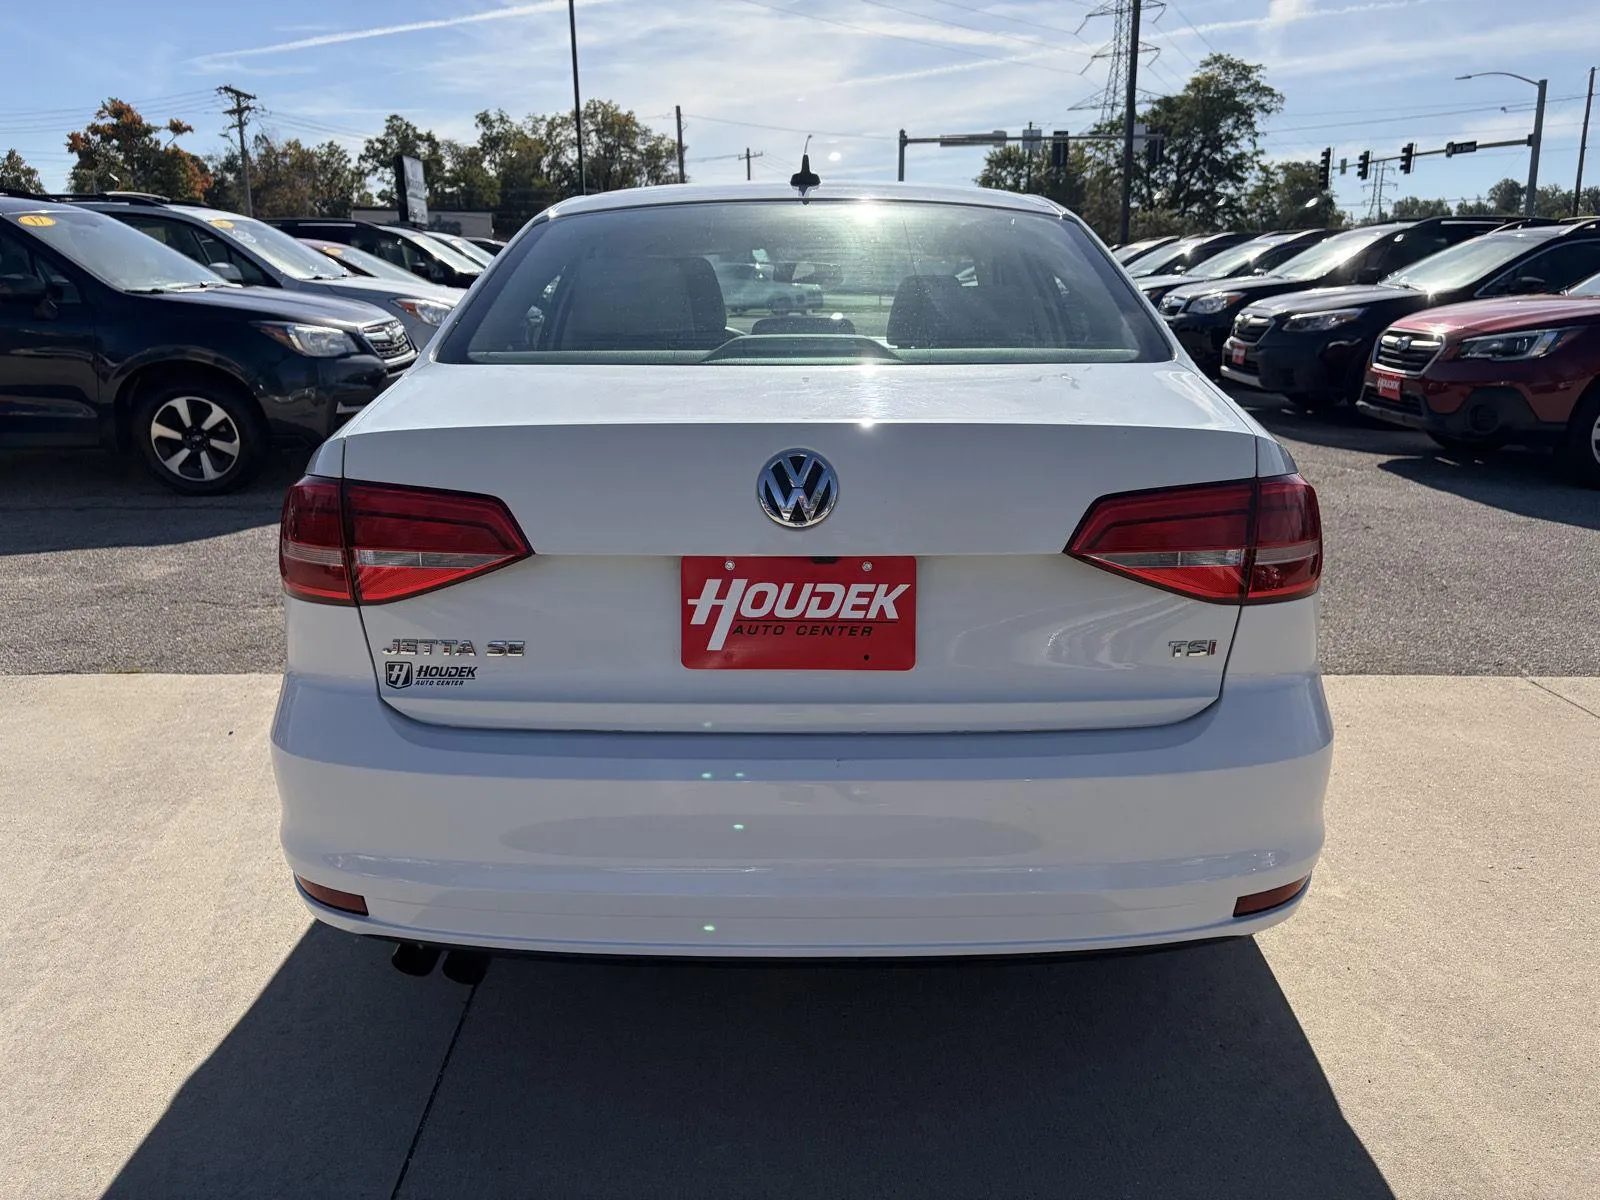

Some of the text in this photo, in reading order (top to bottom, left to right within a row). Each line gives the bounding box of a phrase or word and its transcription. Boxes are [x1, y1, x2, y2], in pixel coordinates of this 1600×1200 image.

[760, 450, 838, 526] VW
[688, 578, 911, 651] HOUDEK
[733, 624, 874, 637] AUTO CENTER
[382, 638, 526, 657] JETTA SE
[1168, 640, 1217, 657] TSI
[416, 665, 478, 678] HOUDEK
